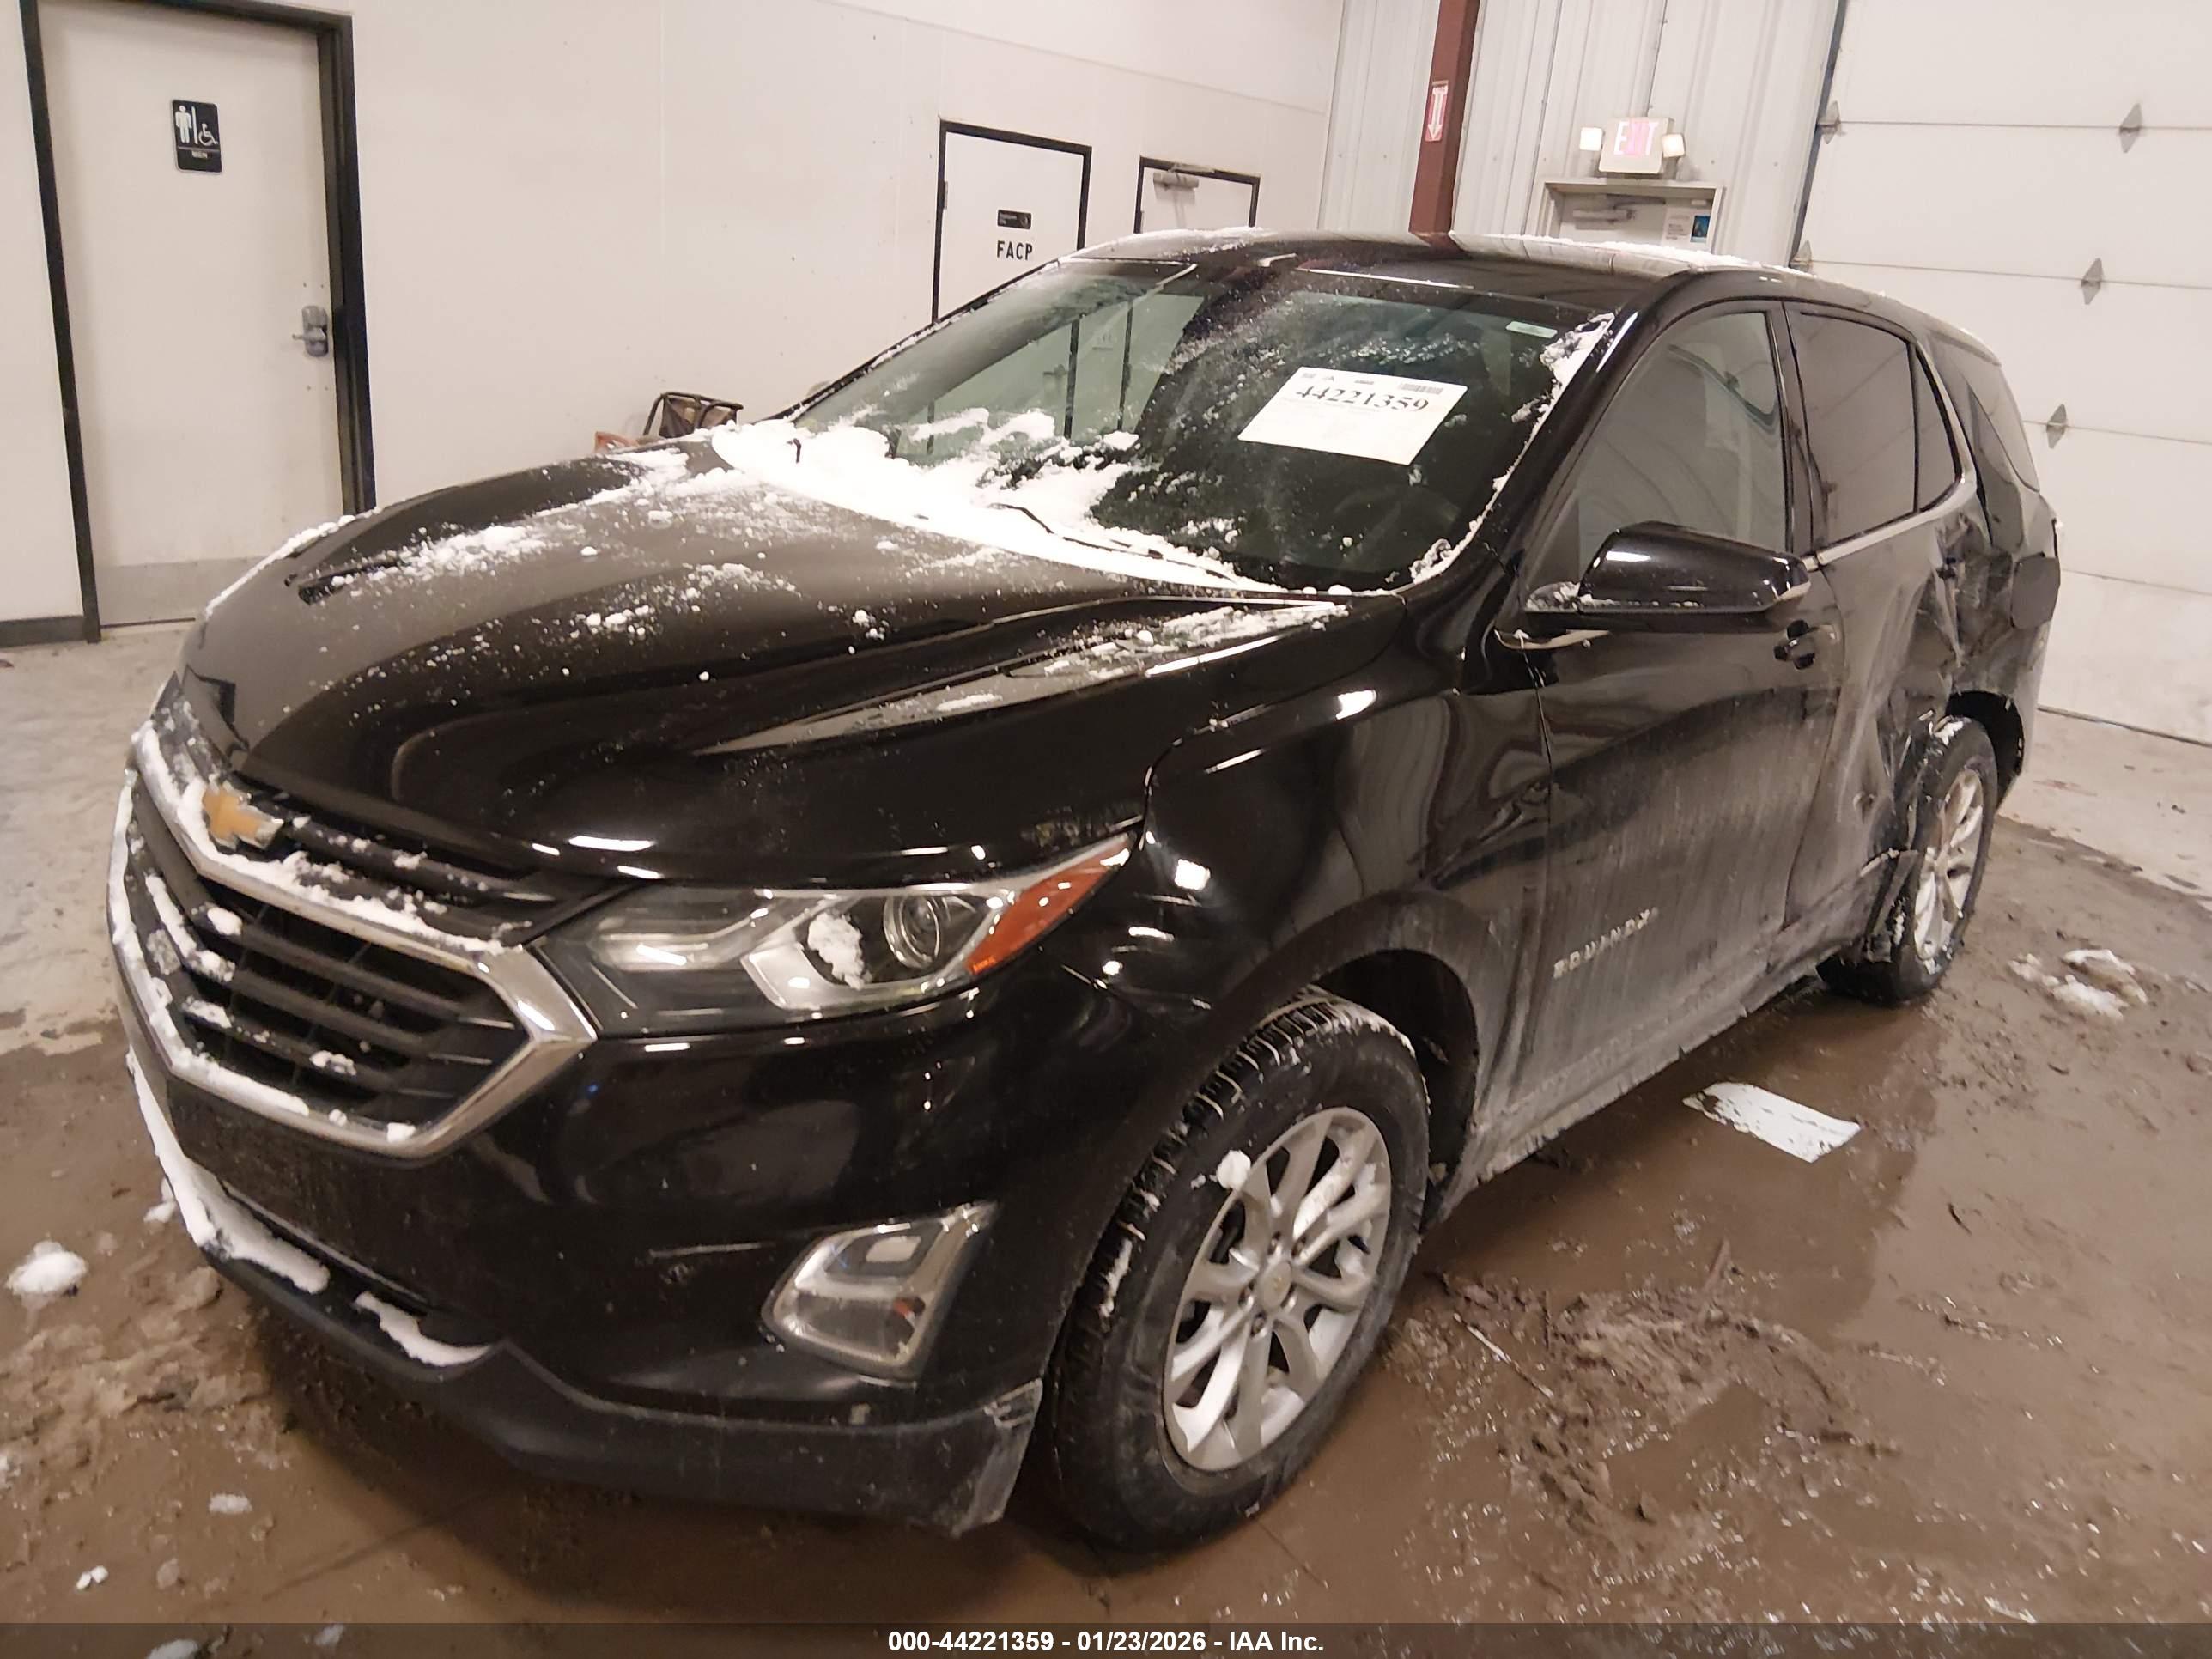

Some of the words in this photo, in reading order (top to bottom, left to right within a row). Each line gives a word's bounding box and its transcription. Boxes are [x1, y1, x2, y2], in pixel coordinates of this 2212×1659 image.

[1613, 120, 1659, 156] EXIT
[997, 240, 1033, 261] FACP
[1296, 385, 1430, 411] 44221359
